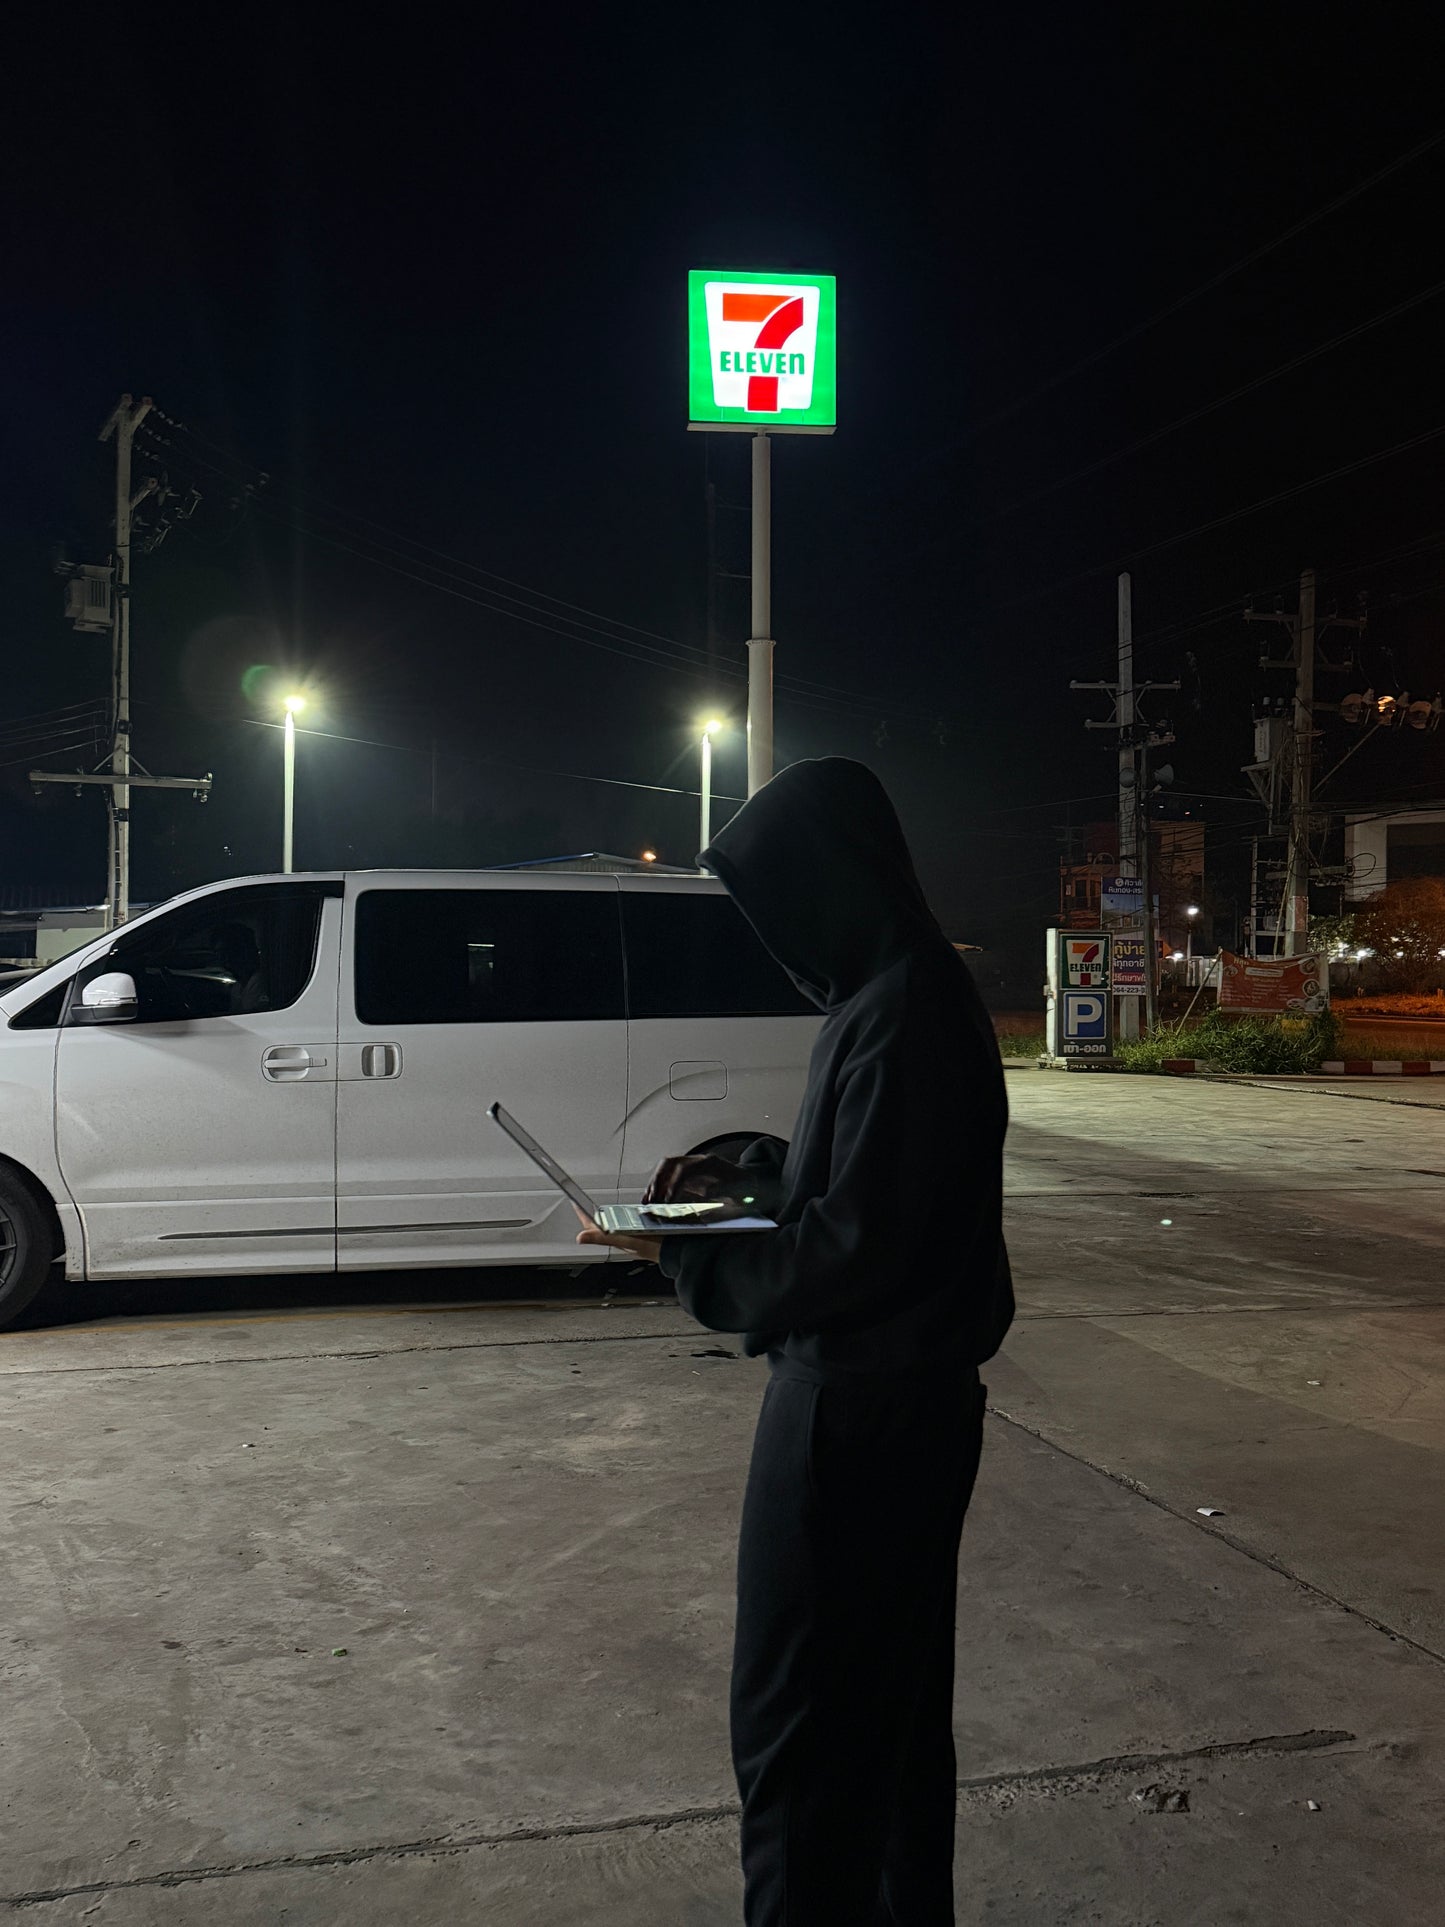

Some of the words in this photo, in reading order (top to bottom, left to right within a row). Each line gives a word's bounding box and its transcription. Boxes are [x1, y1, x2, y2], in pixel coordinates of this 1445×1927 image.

[722, 292, 804, 412] 7
[1068, 996, 1103, 1035] P
[1064, 1041, 1107, 1053] เข้า-ออก
